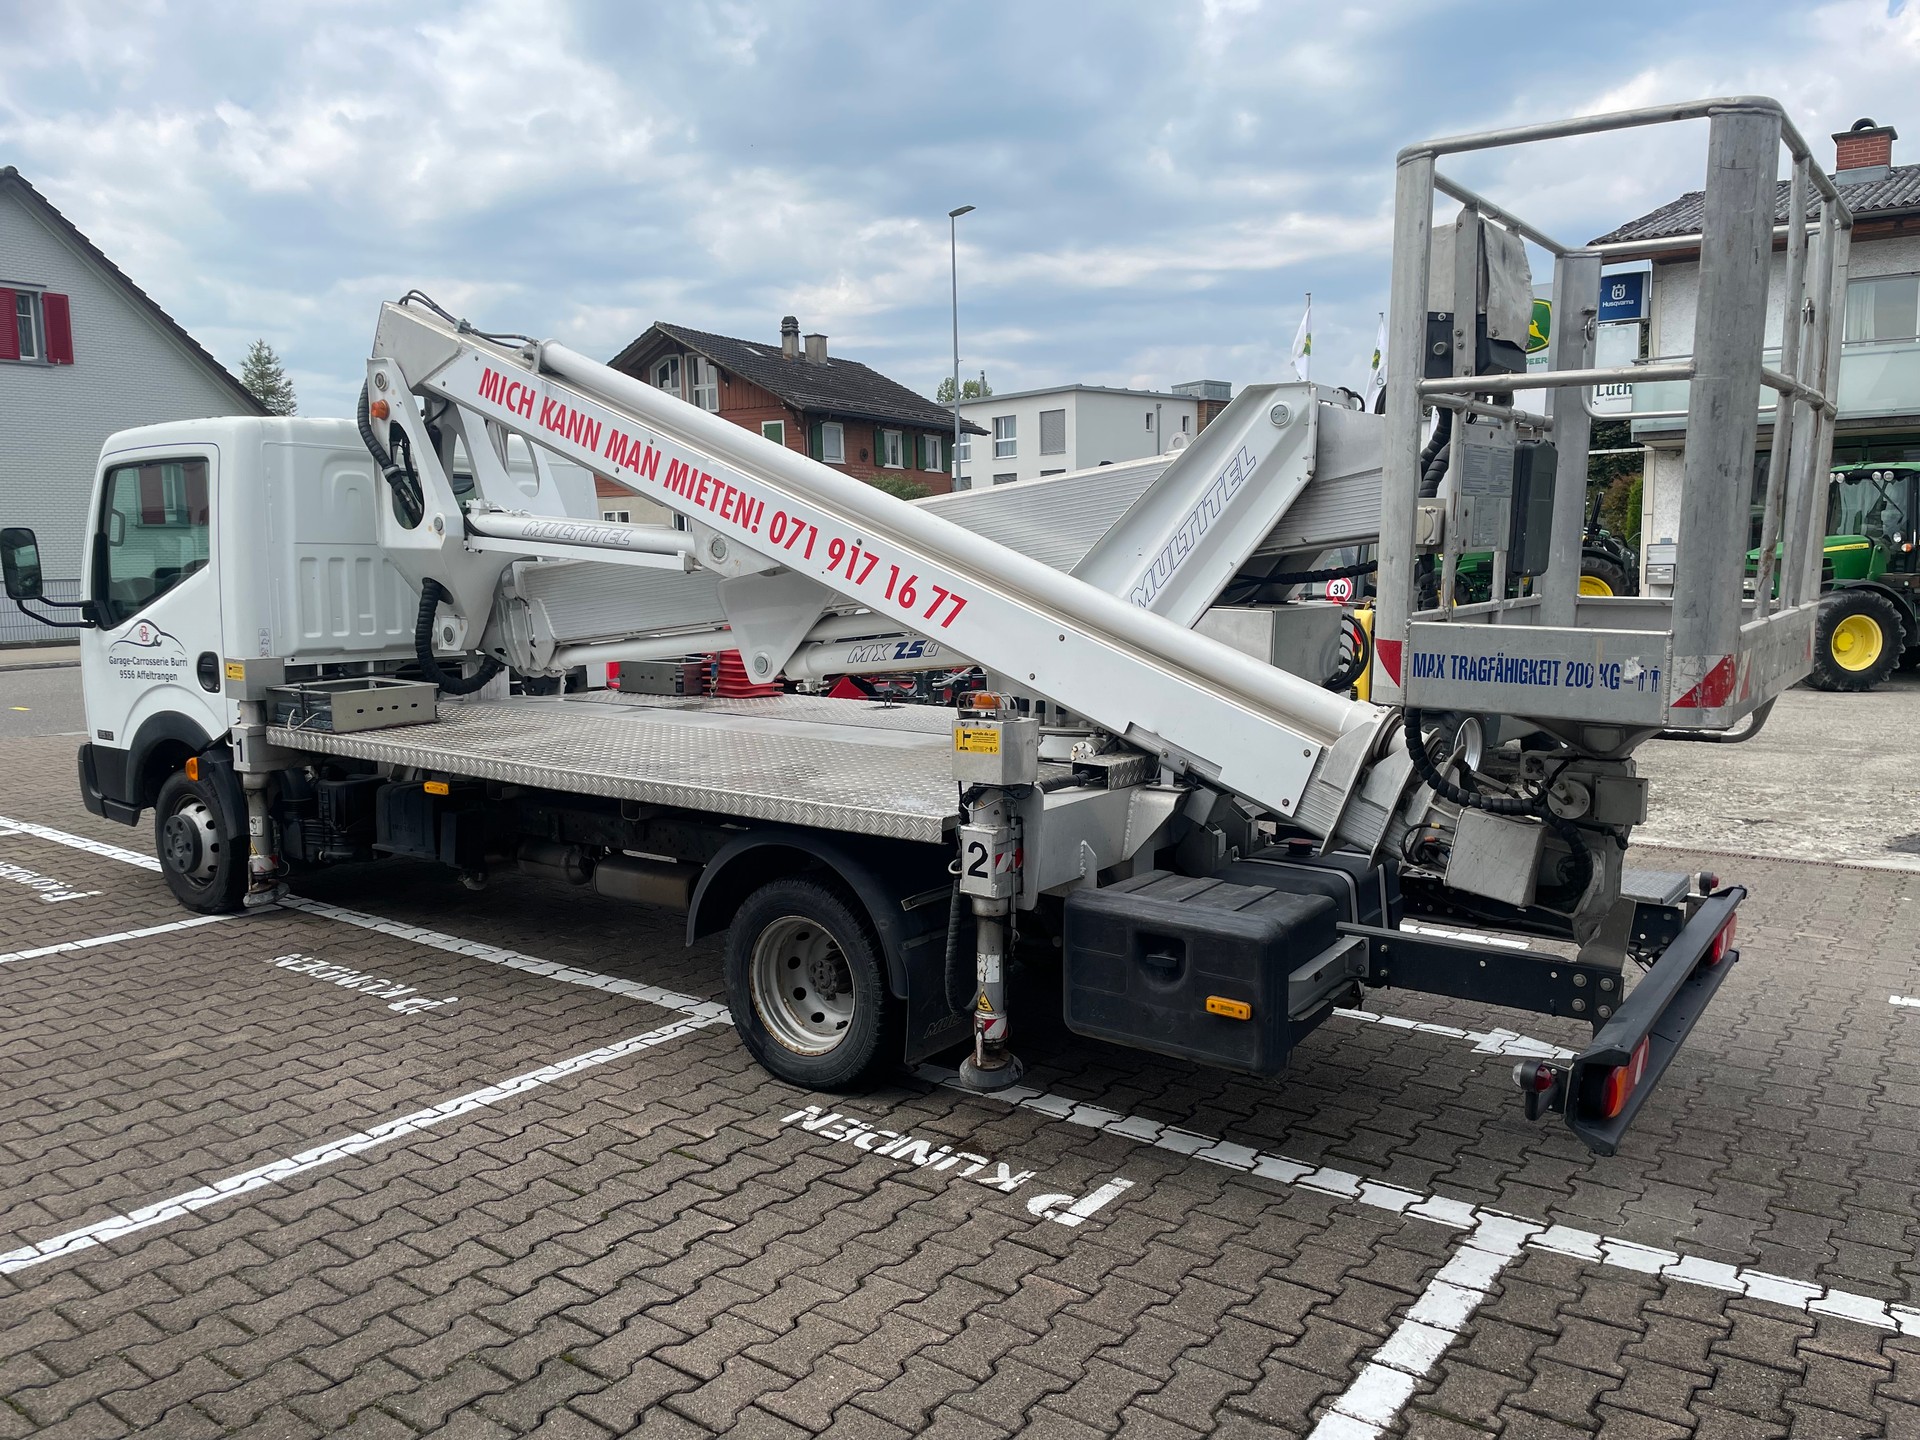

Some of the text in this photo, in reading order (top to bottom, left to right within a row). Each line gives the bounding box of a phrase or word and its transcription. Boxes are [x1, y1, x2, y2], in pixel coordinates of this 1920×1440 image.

[1602, 299, 1634, 308] Husqvarna
[478, 368, 968, 629] MICH KANN MAN MIETEN! 071 917 16 77
[522, 521, 634, 546] MULTITEL
[1130, 445, 1257, 608] MULTITEL
[1333, 584, 1346, 595] 30
[108, 655, 188, 667] Garage-Carrosserie Burri
[847, 640, 940, 664] MX 250
[119, 669, 178, 682] 9556 Affeltrangen
[1412, 652, 1620, 690] MAX TRAGFÄHIGKEIT 200 KG
[236, 738, 243, 763] 1
[967, 840, 989, 879] 2
[779, 1105, 1137, 1227] P KUNDEN
